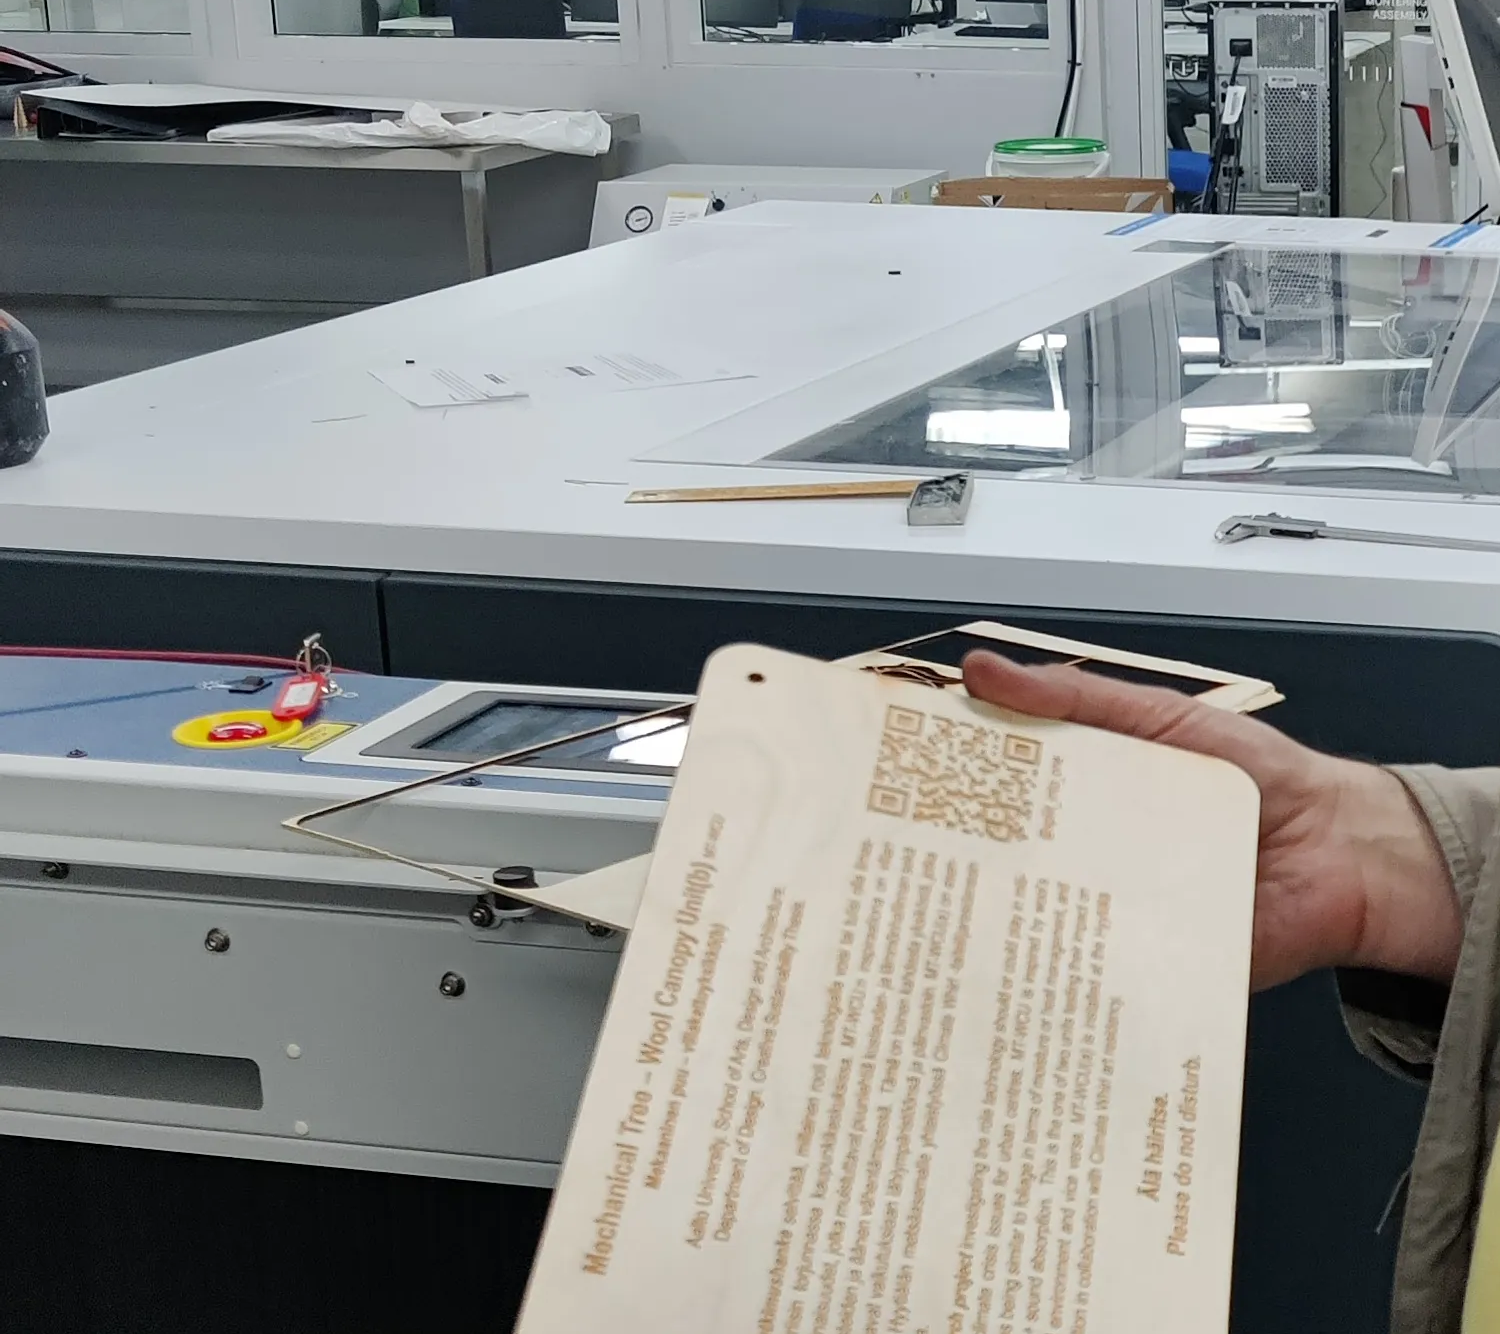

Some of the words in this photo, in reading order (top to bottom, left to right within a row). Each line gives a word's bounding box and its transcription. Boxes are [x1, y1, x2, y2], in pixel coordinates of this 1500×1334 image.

[1372, 9, 1429, 21] ASSEMBLY
[651, 927, 701, 1011] Canopy
[635, 1008, 674, 1068] Wool
[616, 1086, 654, 1139] Tree
[711, 1081, 740, 1132] School
[1175, 1124, 1196, 1158] not
[1172, 1159, 1193, 1187] do
[578, 1140, 640, 1278] Mechanical
[1165, 1188, 1191, 1258] Please
